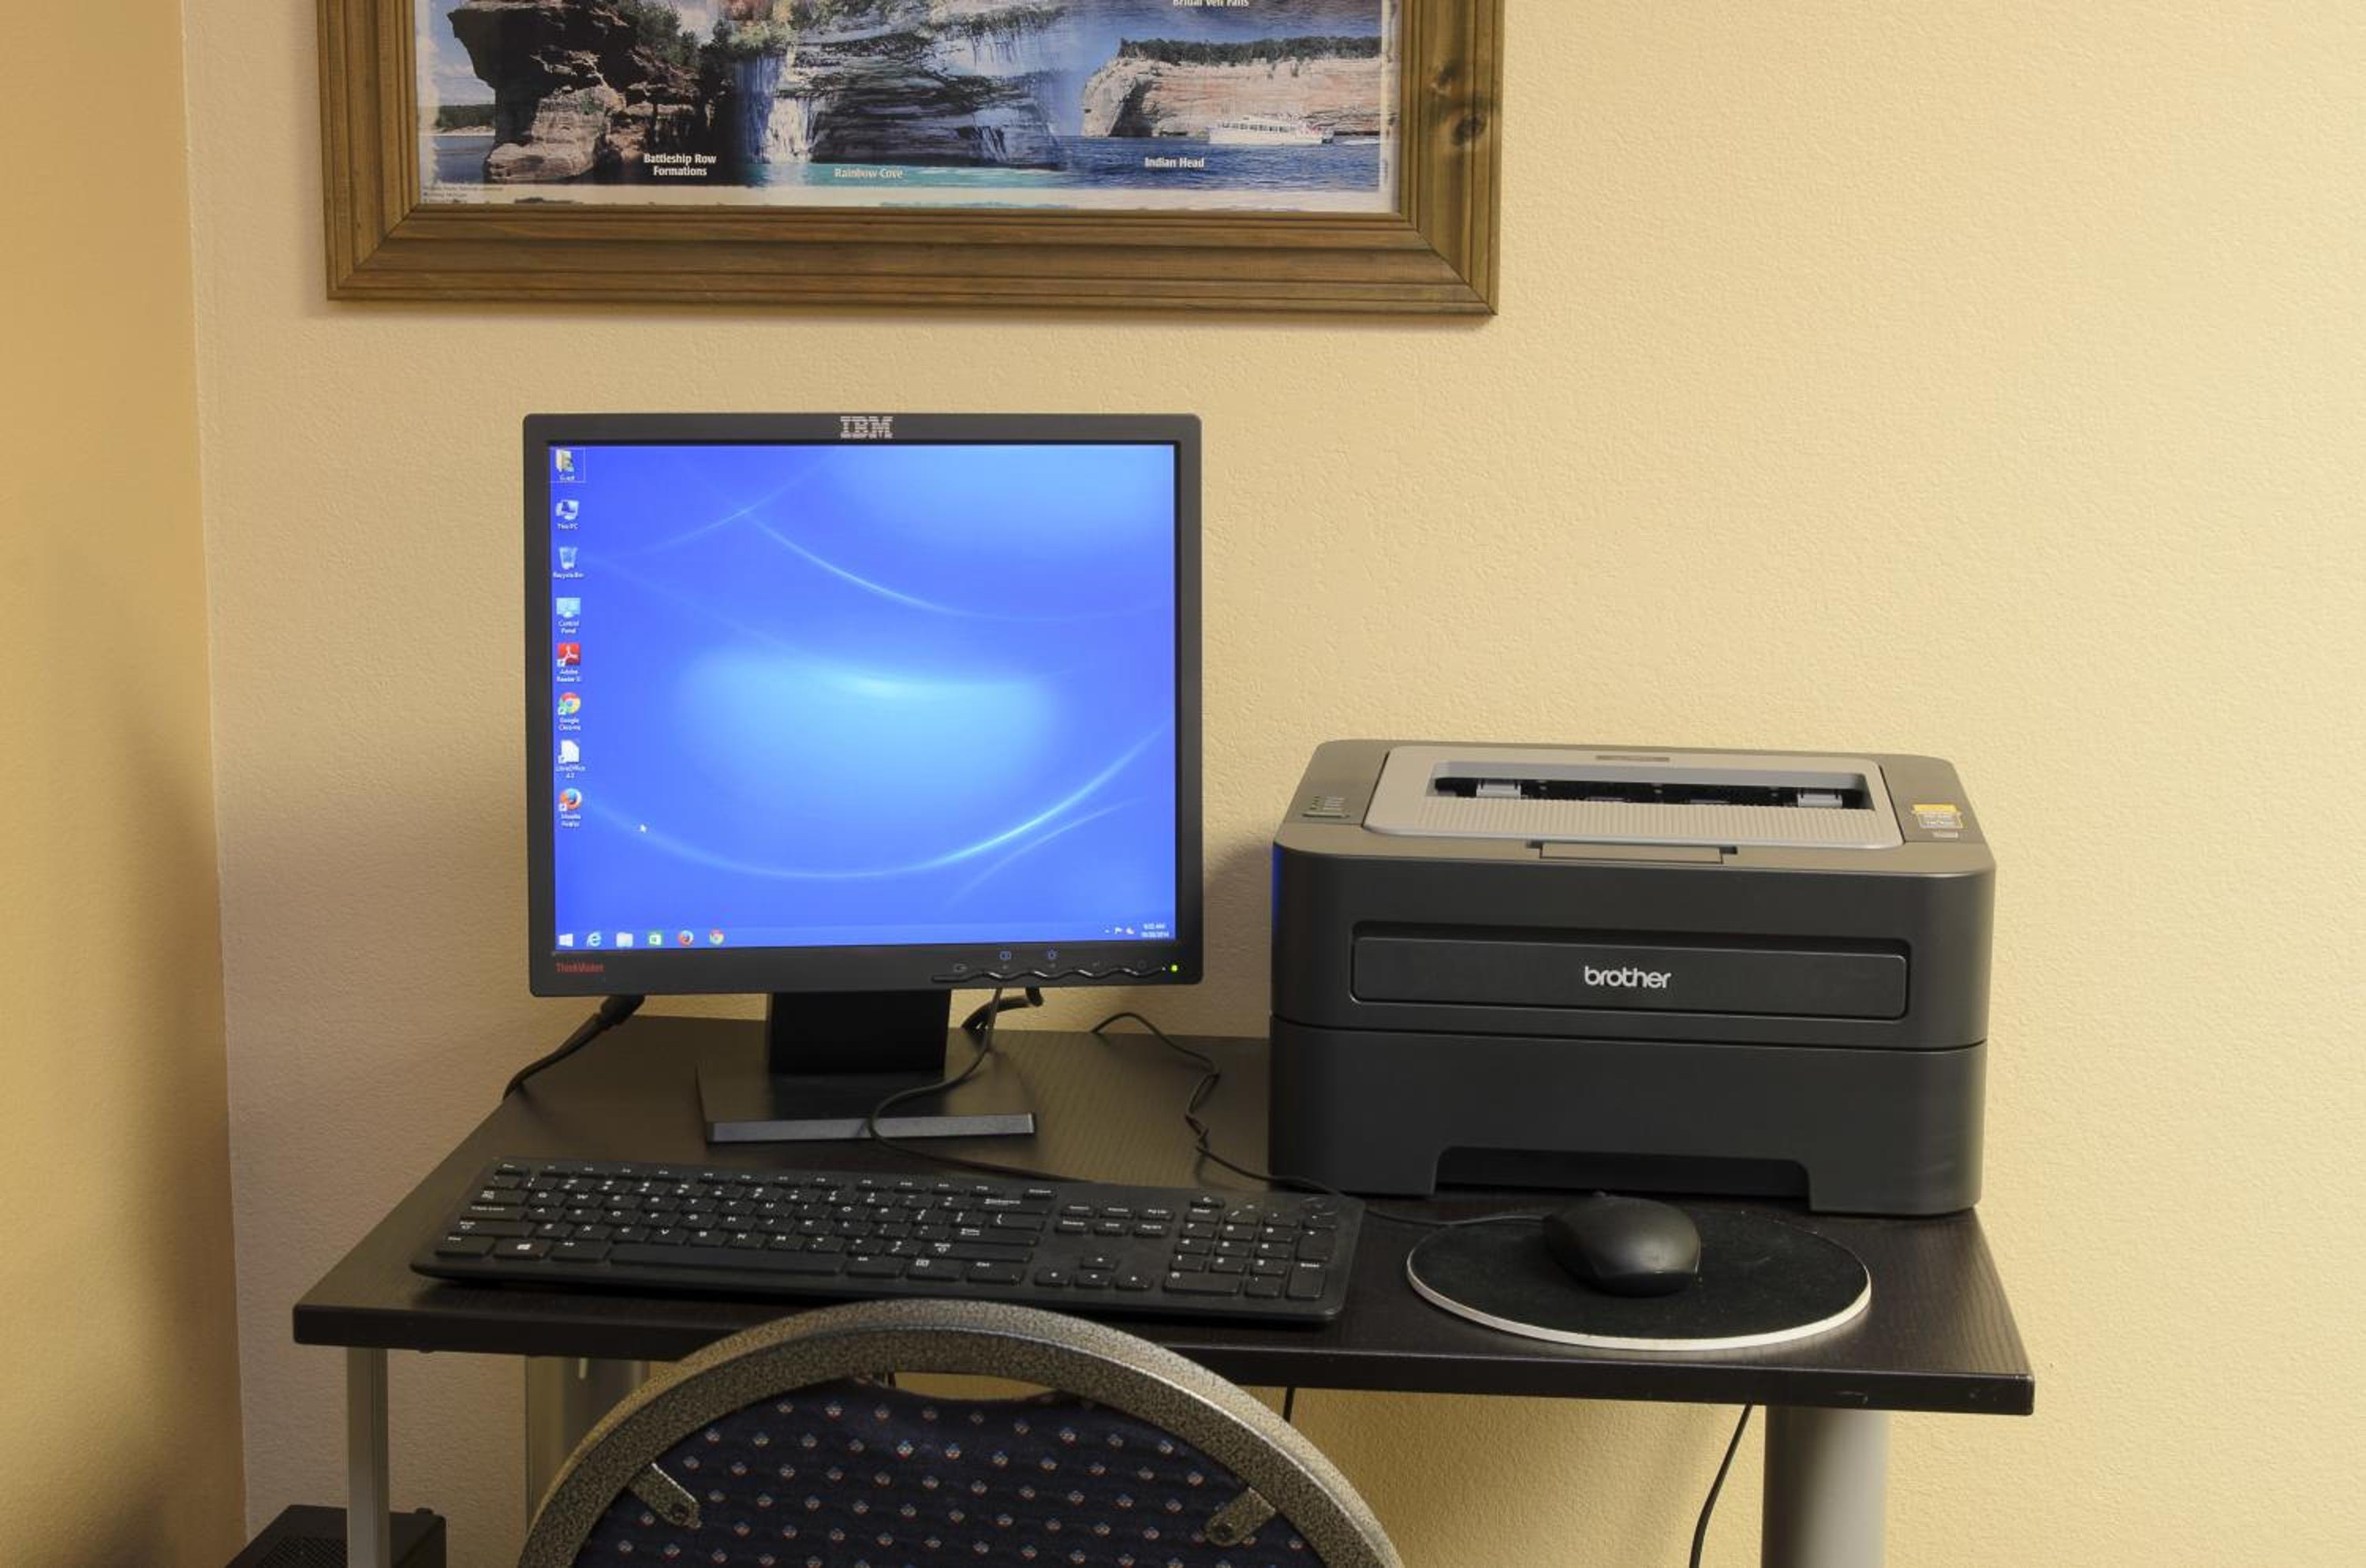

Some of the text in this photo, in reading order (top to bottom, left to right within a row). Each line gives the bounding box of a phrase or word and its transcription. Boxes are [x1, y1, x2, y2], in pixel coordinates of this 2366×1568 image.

[644, 153, 717, 166] Battleship Row
[1144, 157, 1205, 168] Indian Head
[653, 166, 707, 176] Formations
[834, 167, 904, 178] Rainbow Cove
[840, 416, 894, 439] IBM
[1584, 965, 1672, 988] brother
